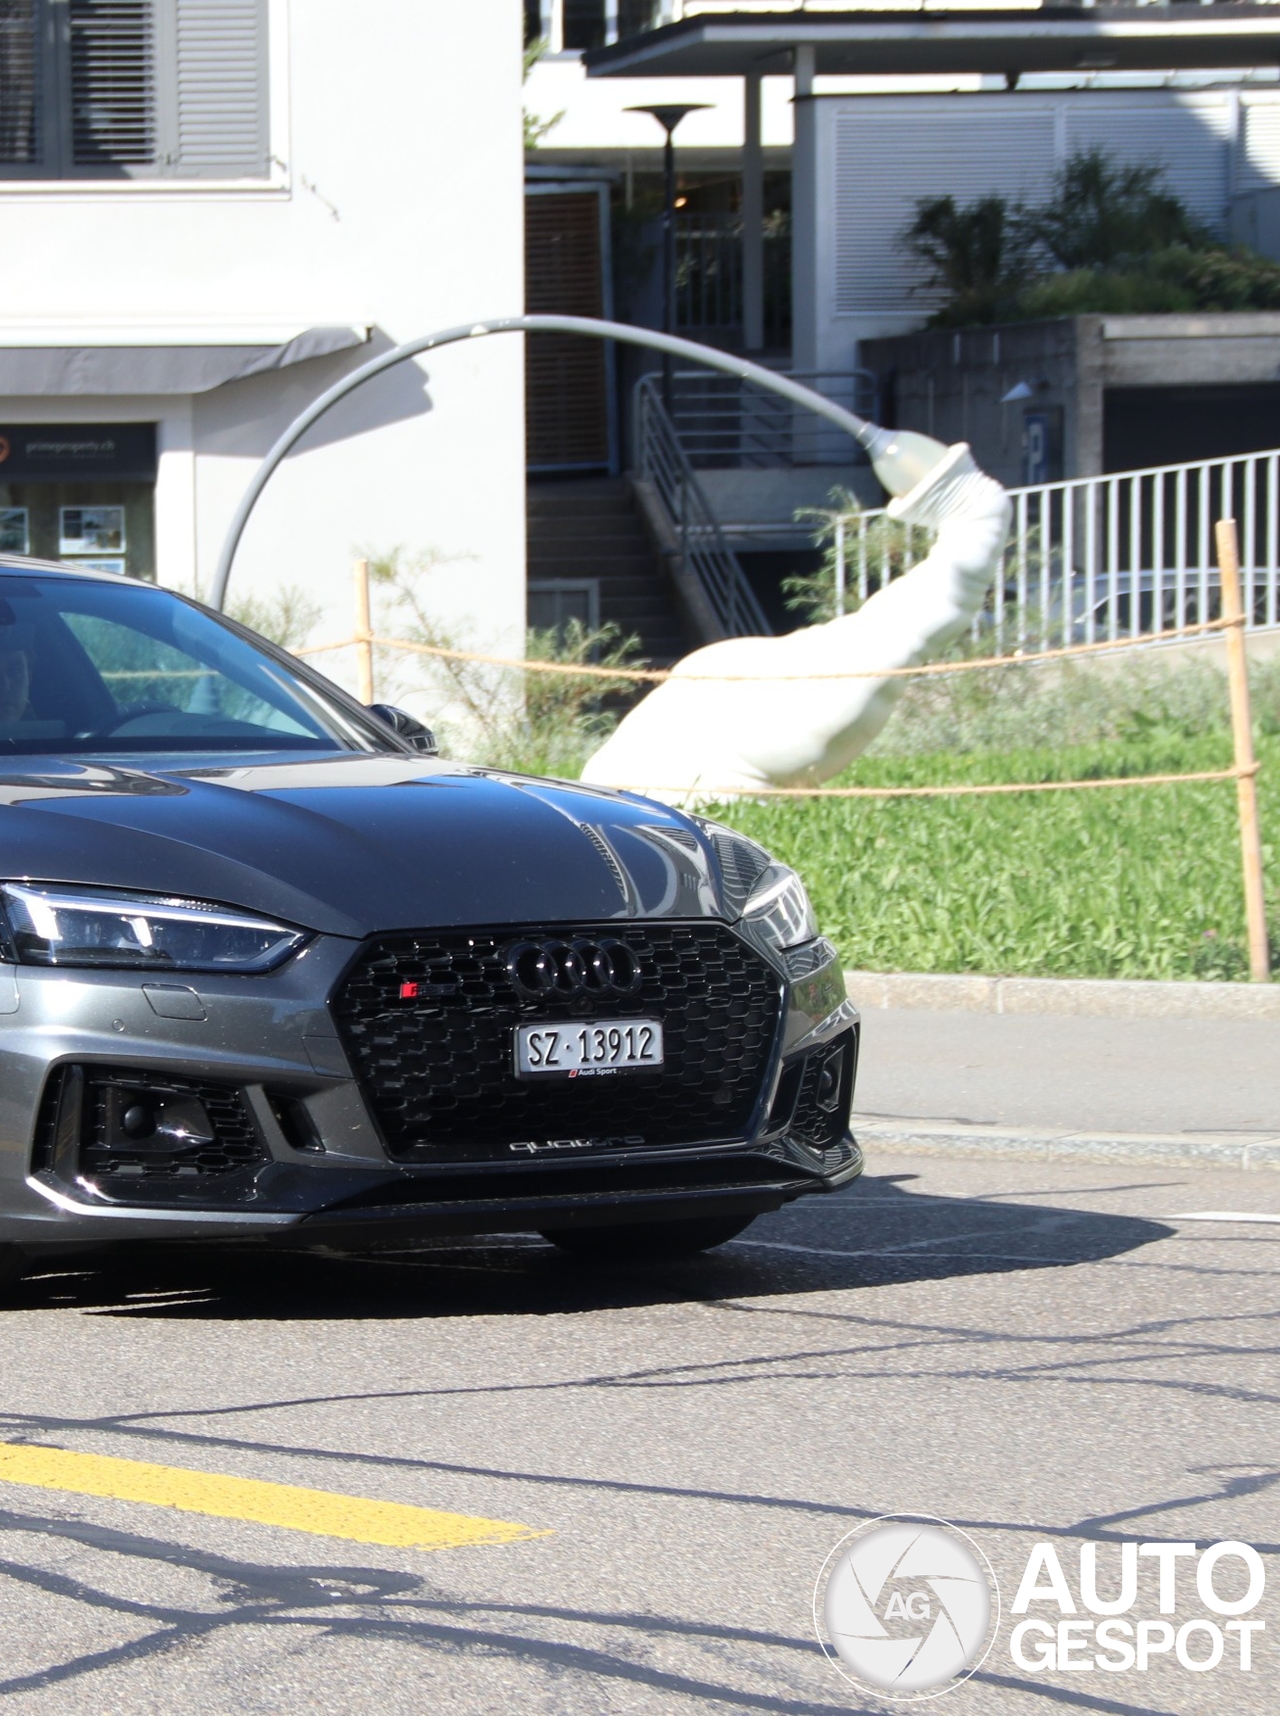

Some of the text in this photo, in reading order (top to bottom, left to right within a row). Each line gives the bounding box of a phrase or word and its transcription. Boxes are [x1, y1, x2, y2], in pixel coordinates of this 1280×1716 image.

[528, 1026, 654, 1066] SZ 13912
[596, 1068, 617, 1077] Sport
